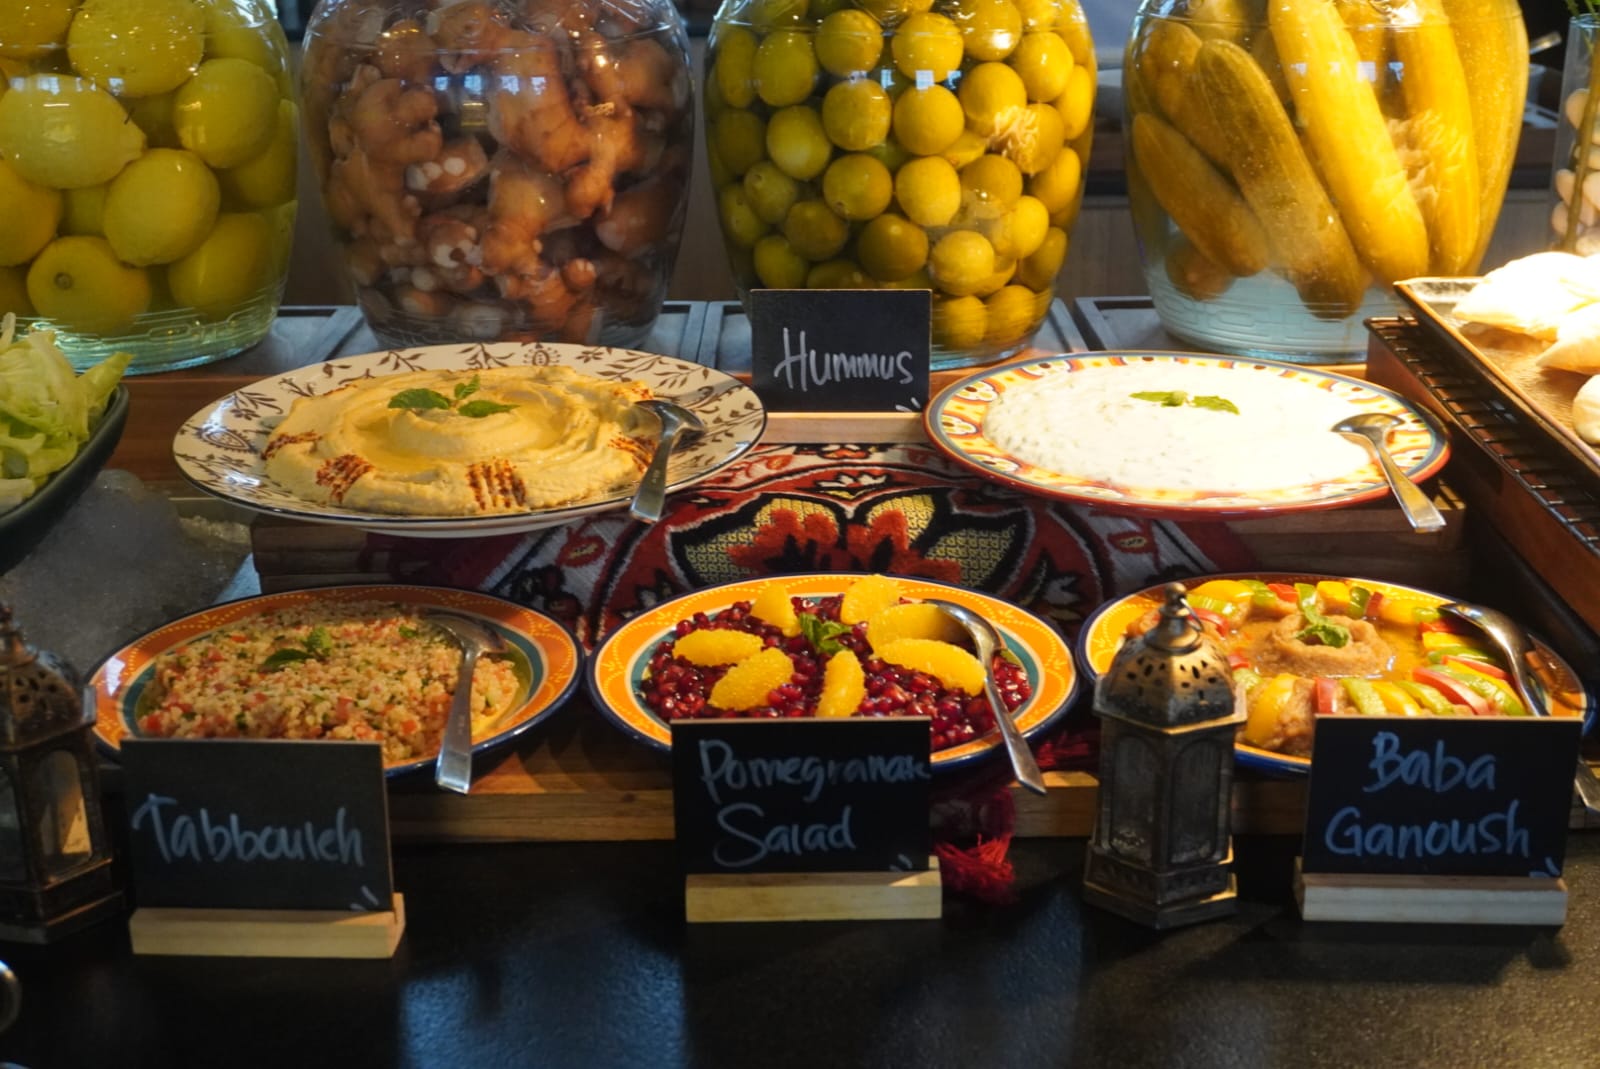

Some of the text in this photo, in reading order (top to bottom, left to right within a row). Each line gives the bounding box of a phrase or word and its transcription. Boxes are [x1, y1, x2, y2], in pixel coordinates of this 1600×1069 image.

[773, 327, 914, 392] Hummus
[1362, 731, 1496, 793] Baba
[131, 793, 364, 867] Tabbouleh
[713, 802, 856, 867] Salad
[1325, 799, 1529, 859] Ganoush
